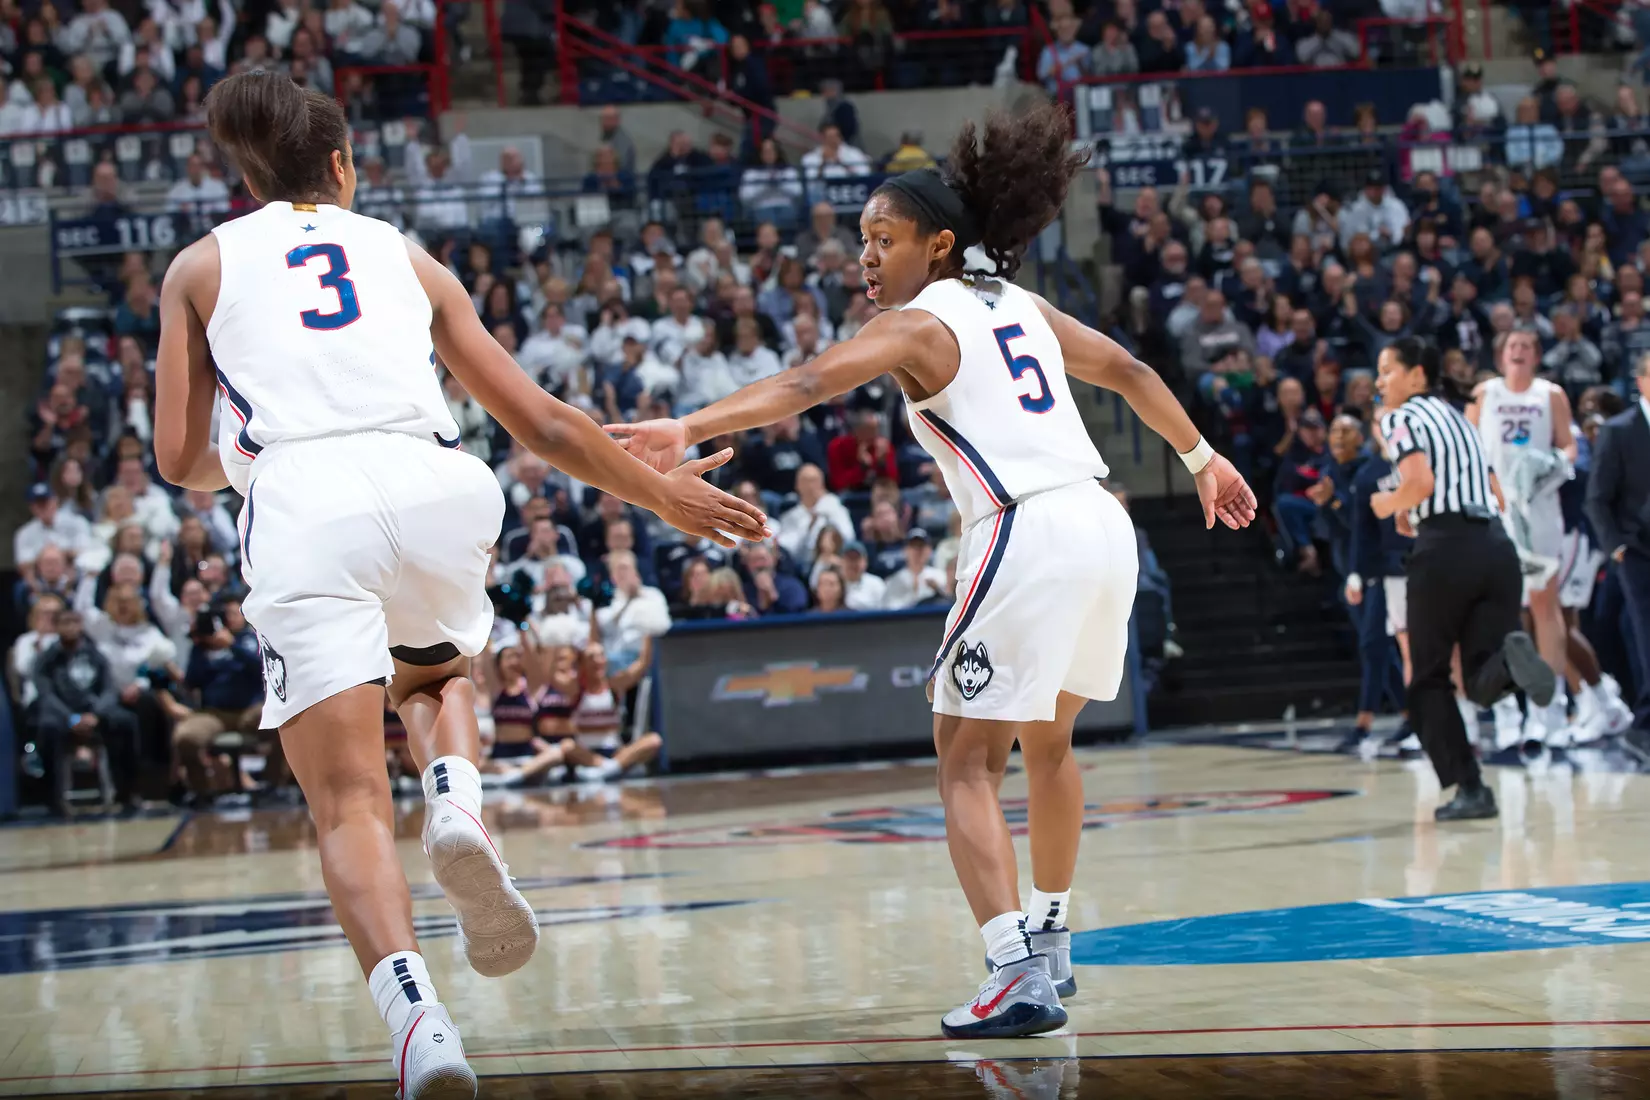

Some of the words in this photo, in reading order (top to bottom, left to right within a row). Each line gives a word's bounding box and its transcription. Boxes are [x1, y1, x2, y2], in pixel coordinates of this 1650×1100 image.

[1115, 167, 1157, 185] SEC
[1173, 158, 1228, 189] 117
[115, 216, 176, 248] 116
[285, 243, 362, 331] 3
[992, 322, 1056, 415] 5
[1501, 419, 1531, 444] 25
